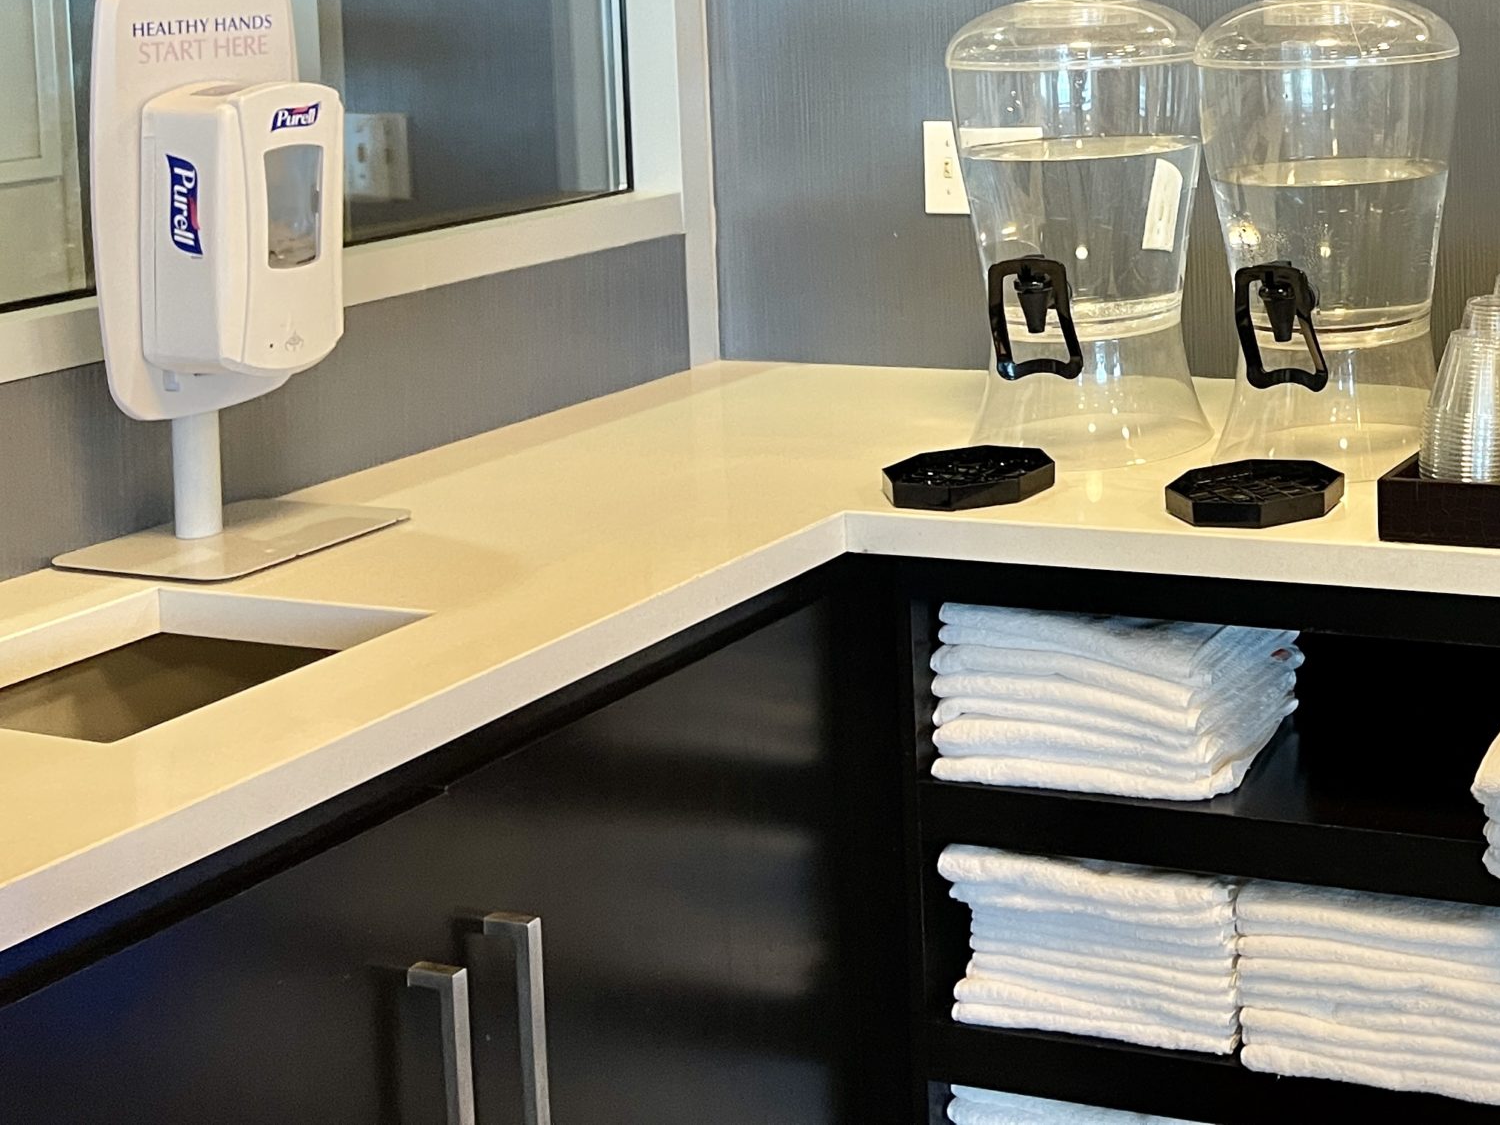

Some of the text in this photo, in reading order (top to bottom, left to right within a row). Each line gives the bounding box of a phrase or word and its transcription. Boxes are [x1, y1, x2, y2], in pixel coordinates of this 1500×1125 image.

[132, 14, 273, 38] HEALTHY HANDS
[138, 34, 269, 64] START HERE
[276, 107, 316, 127] Purell
[173, 166, 196, 247] Purell
